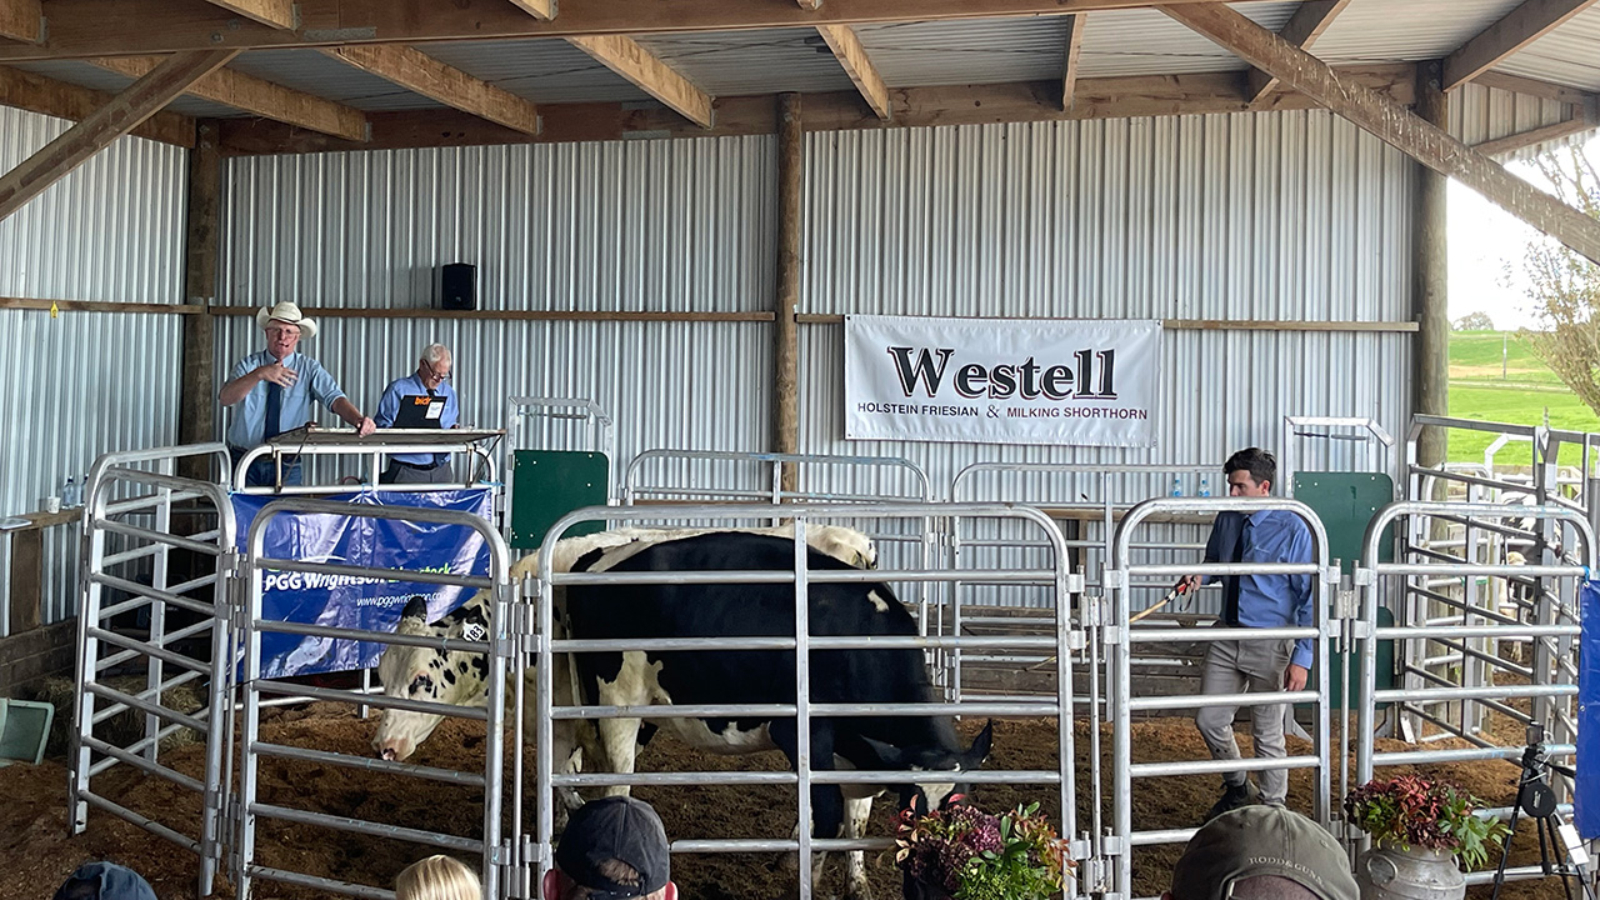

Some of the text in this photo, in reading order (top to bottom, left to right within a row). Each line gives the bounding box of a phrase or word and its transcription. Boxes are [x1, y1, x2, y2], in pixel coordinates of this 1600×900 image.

[887, 346, 1118, 400] Westell
[857, 403, 1148, 420] HOLSTEIN FRIESIAN & MILKING SHORTHORN
[265, 573, 302, 591] PGG
